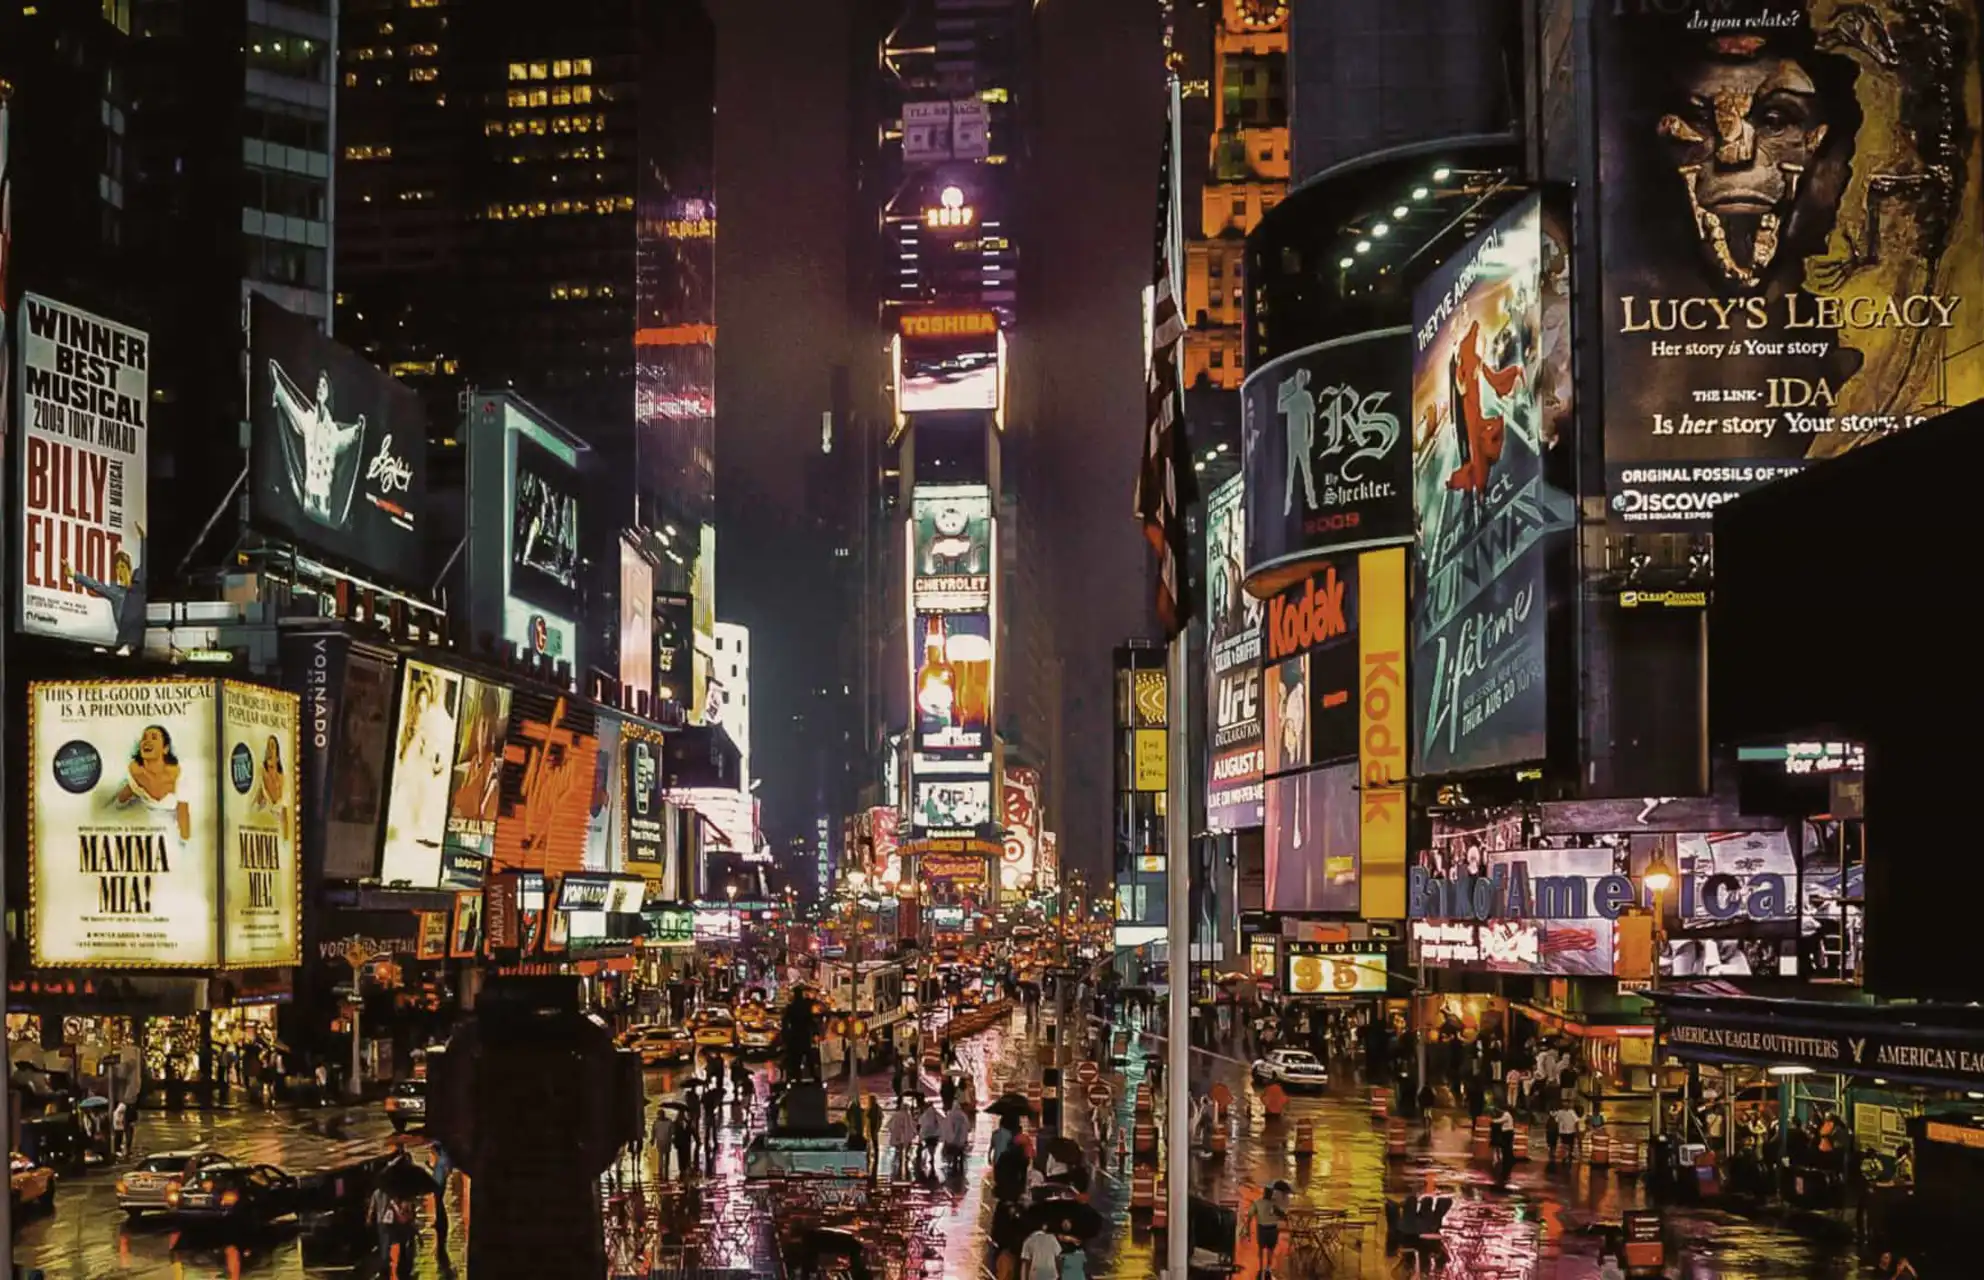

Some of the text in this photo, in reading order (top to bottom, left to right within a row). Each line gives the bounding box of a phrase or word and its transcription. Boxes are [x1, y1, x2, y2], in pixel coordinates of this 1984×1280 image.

[1687, 8, 1800, 33] do you relate?
[901, 313, 996, 335] TOSHIBA
[1418, 290, 1453, 352] THEY'VE
[1620, 293, 1961, 333] LUCY'S LEGACY
[27, 299, 145, 370] WINNER
[1651, 338, 1829, 359] Her story is Your story
[56, 345, 120, 389] BEST
[25, 366, 144, 428] MUSICAL
[1692, 390, 1719, 402] THE
[1764, 377, 1840, 408] IDA
[34, 400, 136, 454] 2009 TONY AWARD
[1652, 415, 1673, 435] Is
[1679, 412, 1718, 435] her
[1722, 416, 1778, 438] story
[1784, 411, 1836, 433] Your
[27, 436, 108, 525] BILLY
[109, 459, 124, 528] THE MUSICAL
[1622, 470, 1690, 484] ORIGINAL
[1693, 468, 1752, 482] FOSSILS
[1755, 467, 1775, 480] OF
[26, 513, 123, 598] ELLIOT
[915, 577, 987, 592] CHEVROLET
[1269, 567, 1346, 659] Kodak
[61, 703, 73, 717] IS
[77, 704, 86, 717] A
[78, 686, 150, 701] FEEL-GOOD
[154, 684, 213, 701] MUSICAL
[313, 639, 327, 748] VORNADO
[1218, 667, 1259, 727] UFC
[1364, 650, 1400, 824] Kodak
[1213, 750, 1264, 780] AUGUST 8
[79, 834, 170, 873] MAMMA
[239, 832, 280, 870] MAMMA
[98, 874, 151, 914] MIA!
[248, 871, 273, 908] MIA!
[1289, 943, 1389, 954] MARQUIS
[1670, 1026, 1840, 1059] AMERICAN EAGLE OUTFITTERS
[1877, 1045, 1957, 1069] AMERICAN
